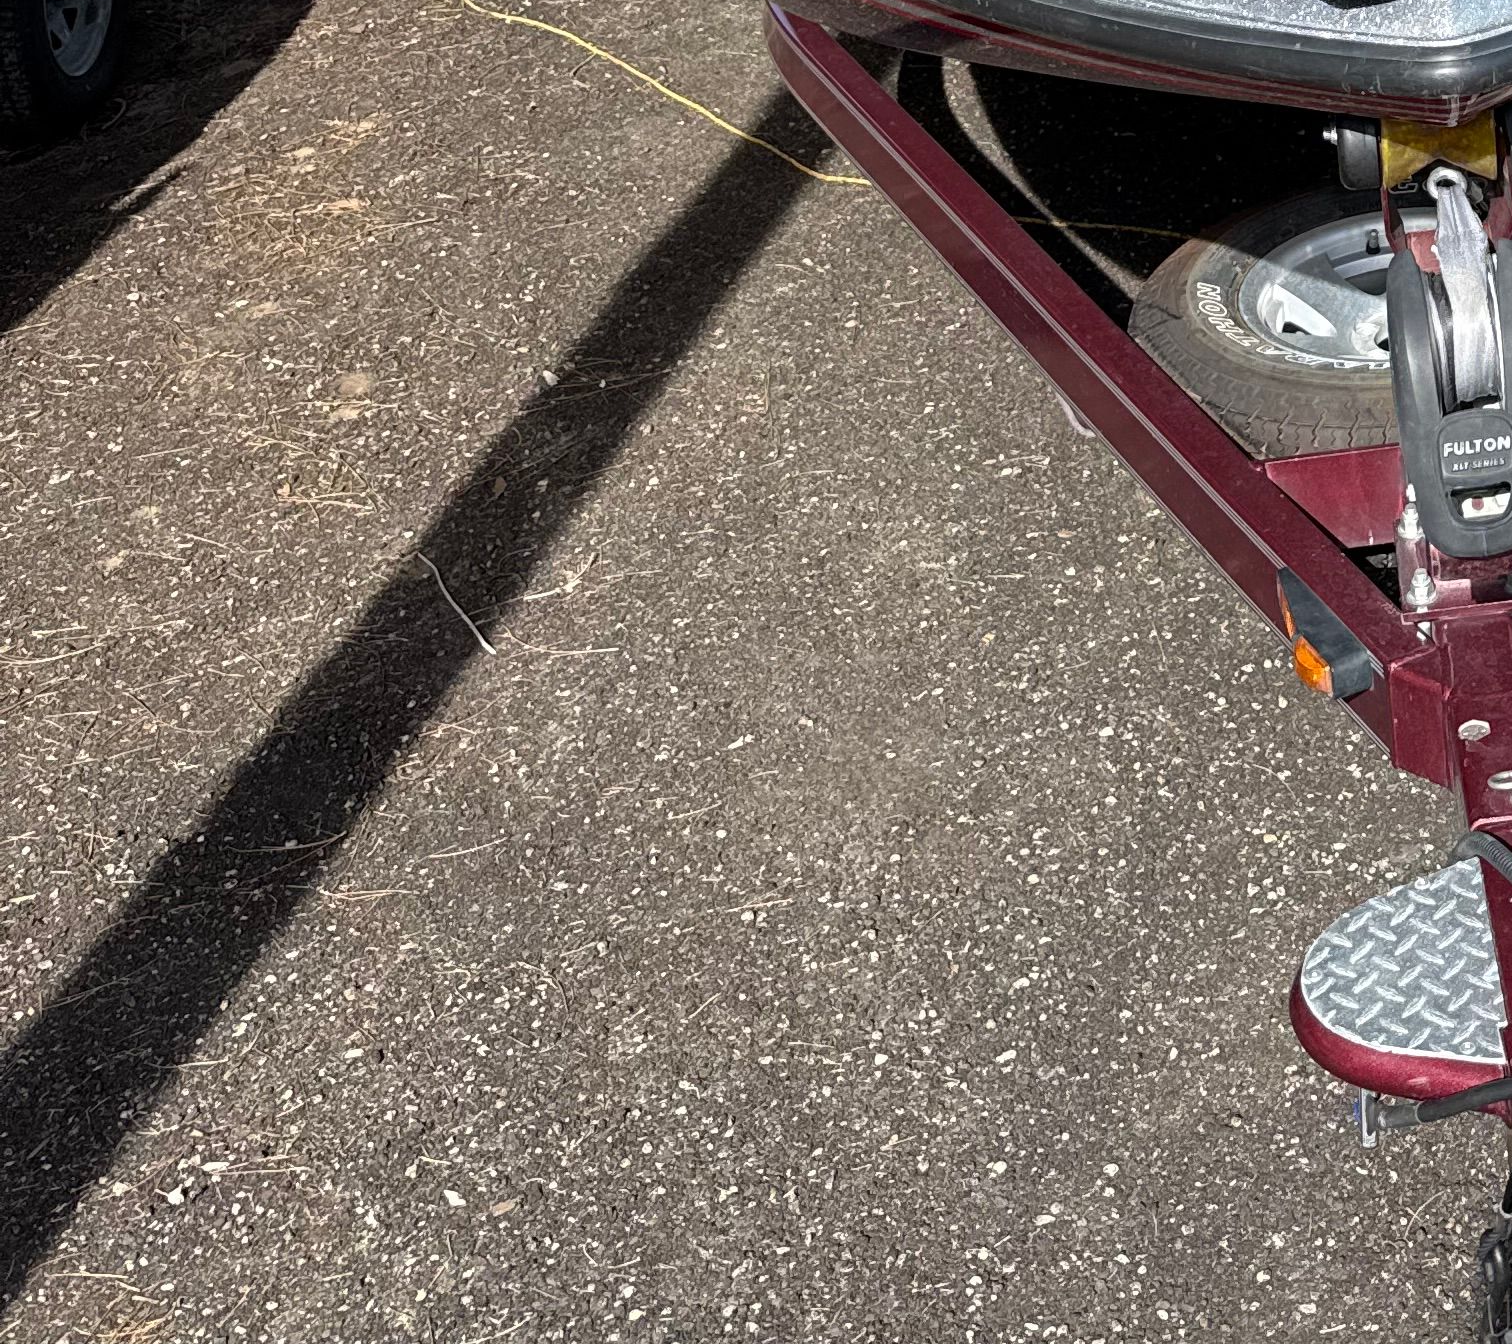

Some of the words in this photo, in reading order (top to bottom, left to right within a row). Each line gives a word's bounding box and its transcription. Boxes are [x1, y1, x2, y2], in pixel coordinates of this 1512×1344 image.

[1196, 282, 1391, 370] ARATHON
[1443, 435, 1511, 458] FULTON
[1472, 458, 1505, 469] SERIES
